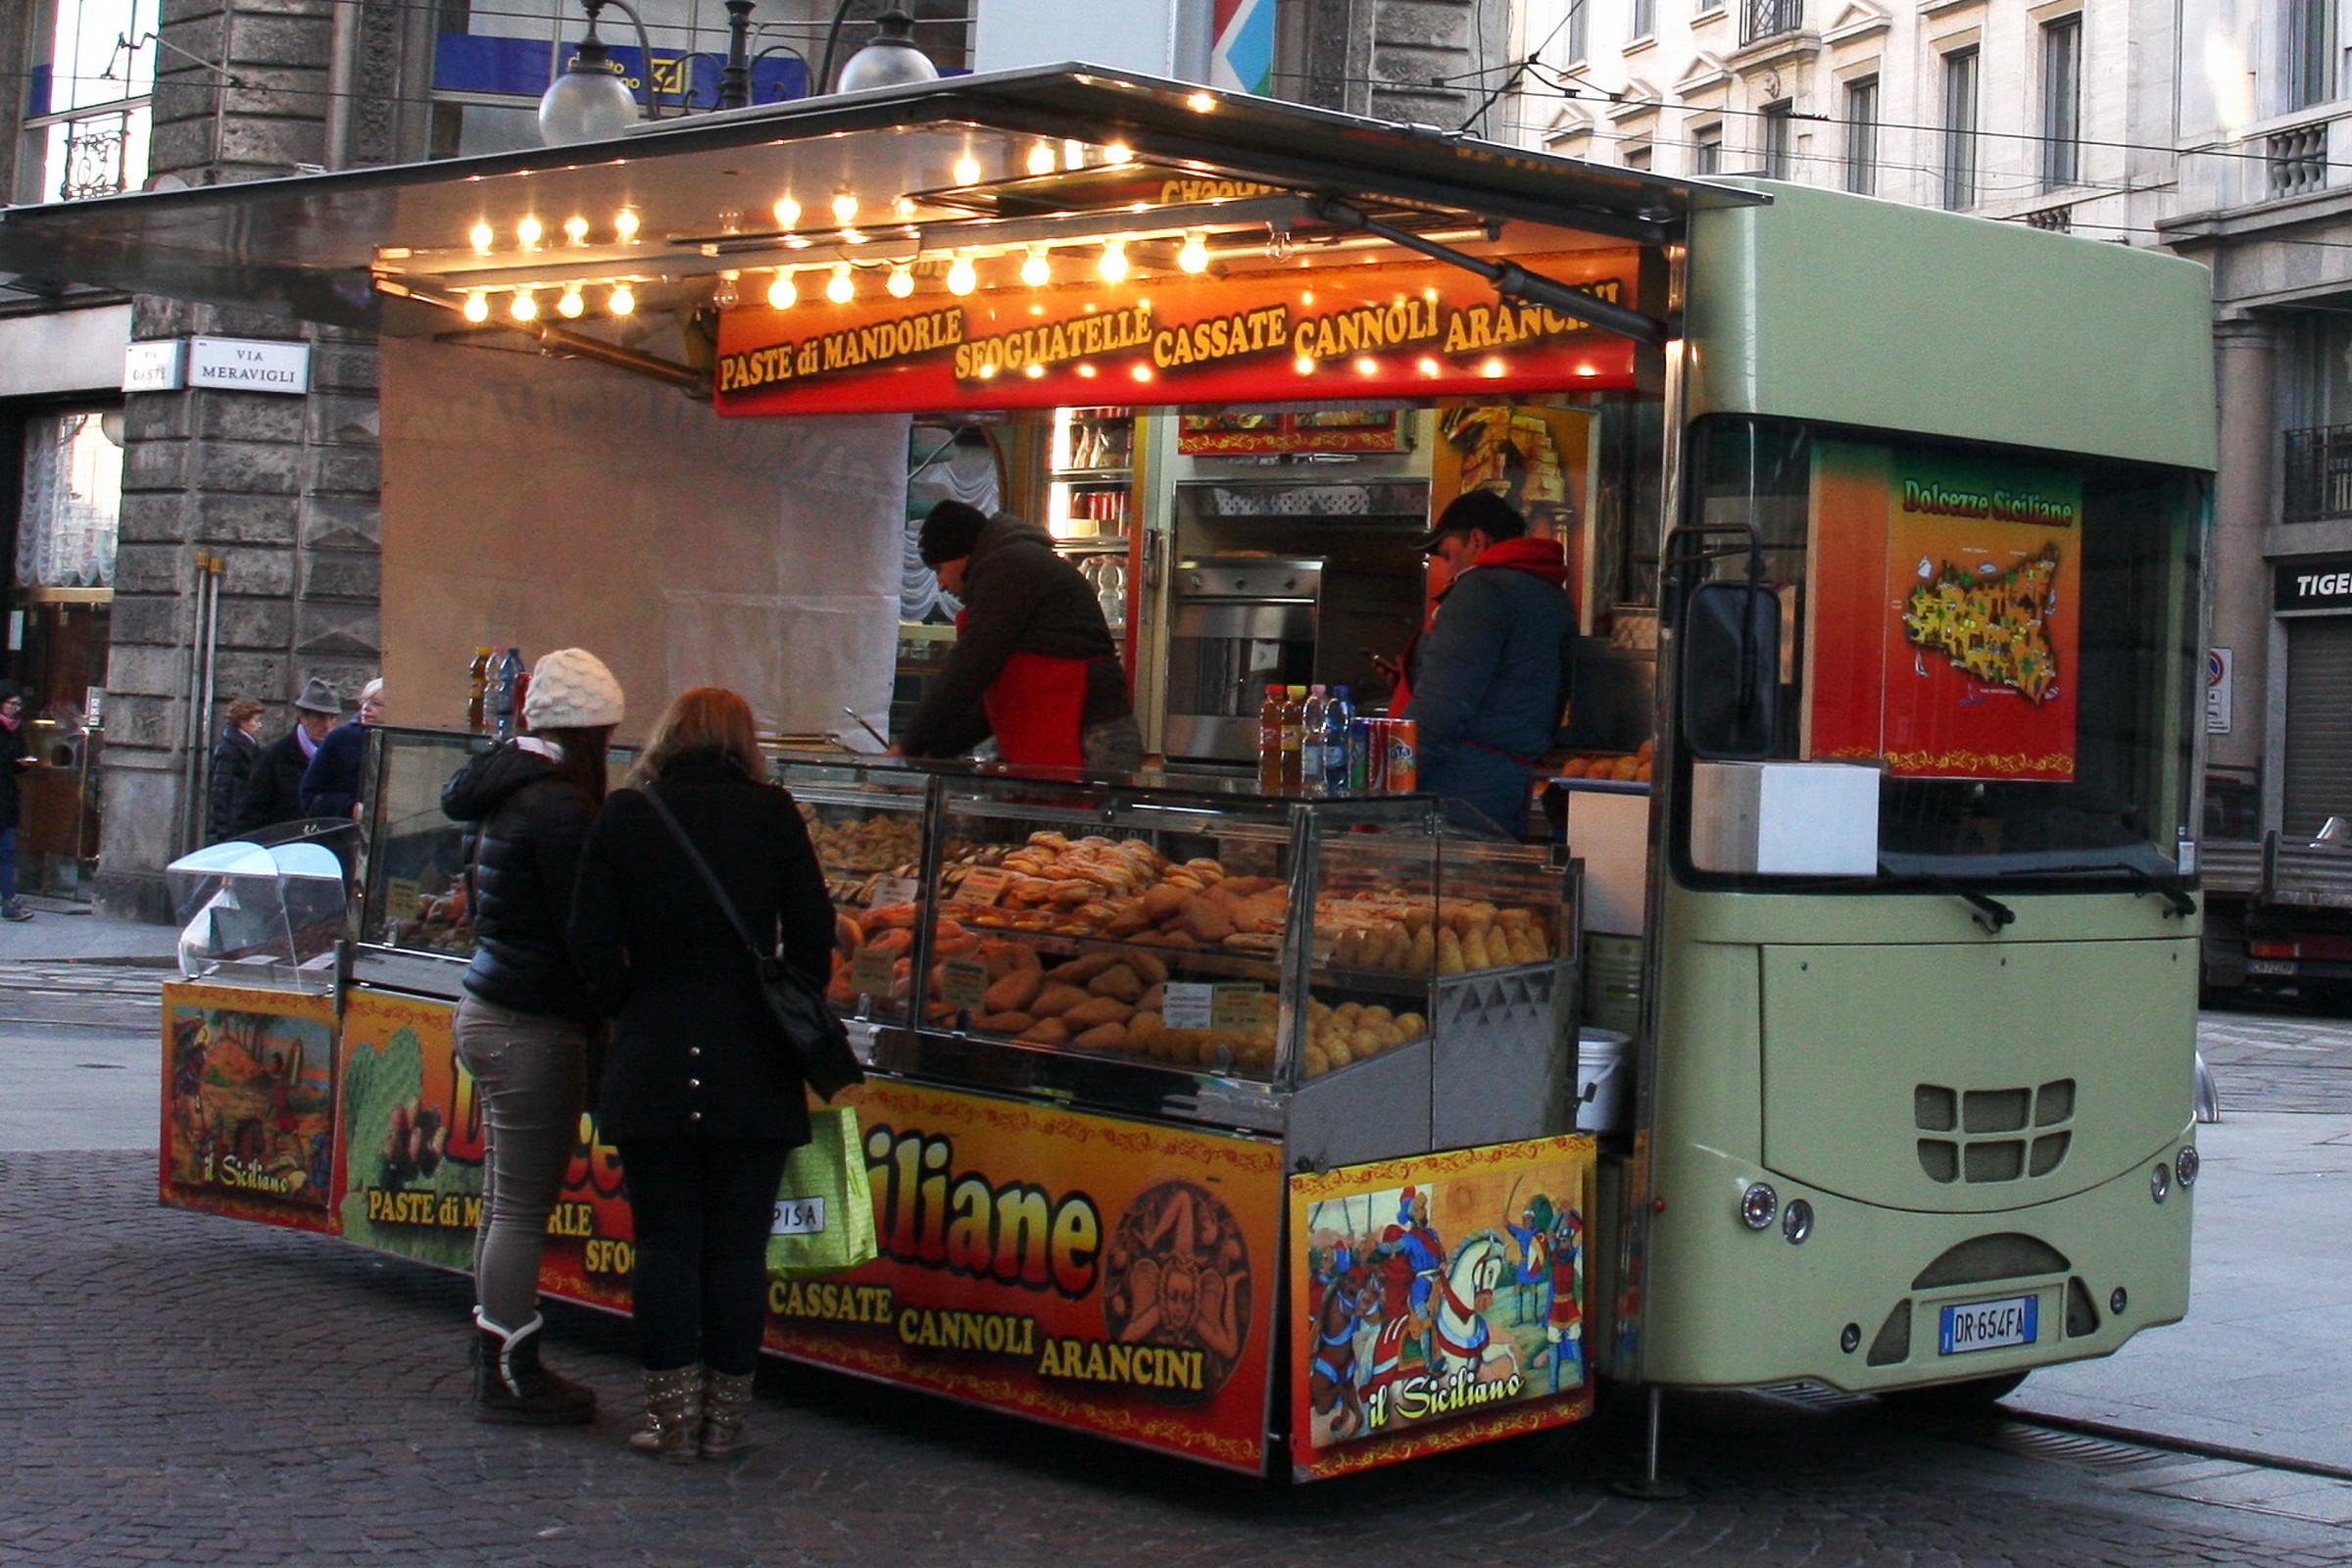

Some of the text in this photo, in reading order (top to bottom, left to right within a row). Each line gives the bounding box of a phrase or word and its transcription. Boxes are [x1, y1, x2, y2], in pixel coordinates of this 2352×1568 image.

[237, 350, 263, 362] VIA
[720, 346, 793, 391] PASTE
[797, 340, 817, 374] di
[823, 309, 962, 370] MANDORLE
[956, 308, 1152, 380] SFOGLIATELLE
[1153, 308, 1287, 368] CASSATE
[1294, 299, 1439, 359] CANNOLI
[201, 366, 295, 383] MERAVIGLI
[1904, 479, 2074, 527] Dolcezze Siciliane
[2297, 572, 2352, 596] TIGE
[220, 1154, 289, 1194] Siciliano
[368, 1190, 435, 1224] PASTE
[440, 1194, 460, 1226] di
[867, 1130, 1100, 1296] iliane
[768, 1281, 892, 1323] CASSATE
[899, 1307, 1034, 1355] CANNOLI
[1039, 1339, 1202, 1390] ARANCINI
[1369, 1367, 1525, 1428] il Siciliano
